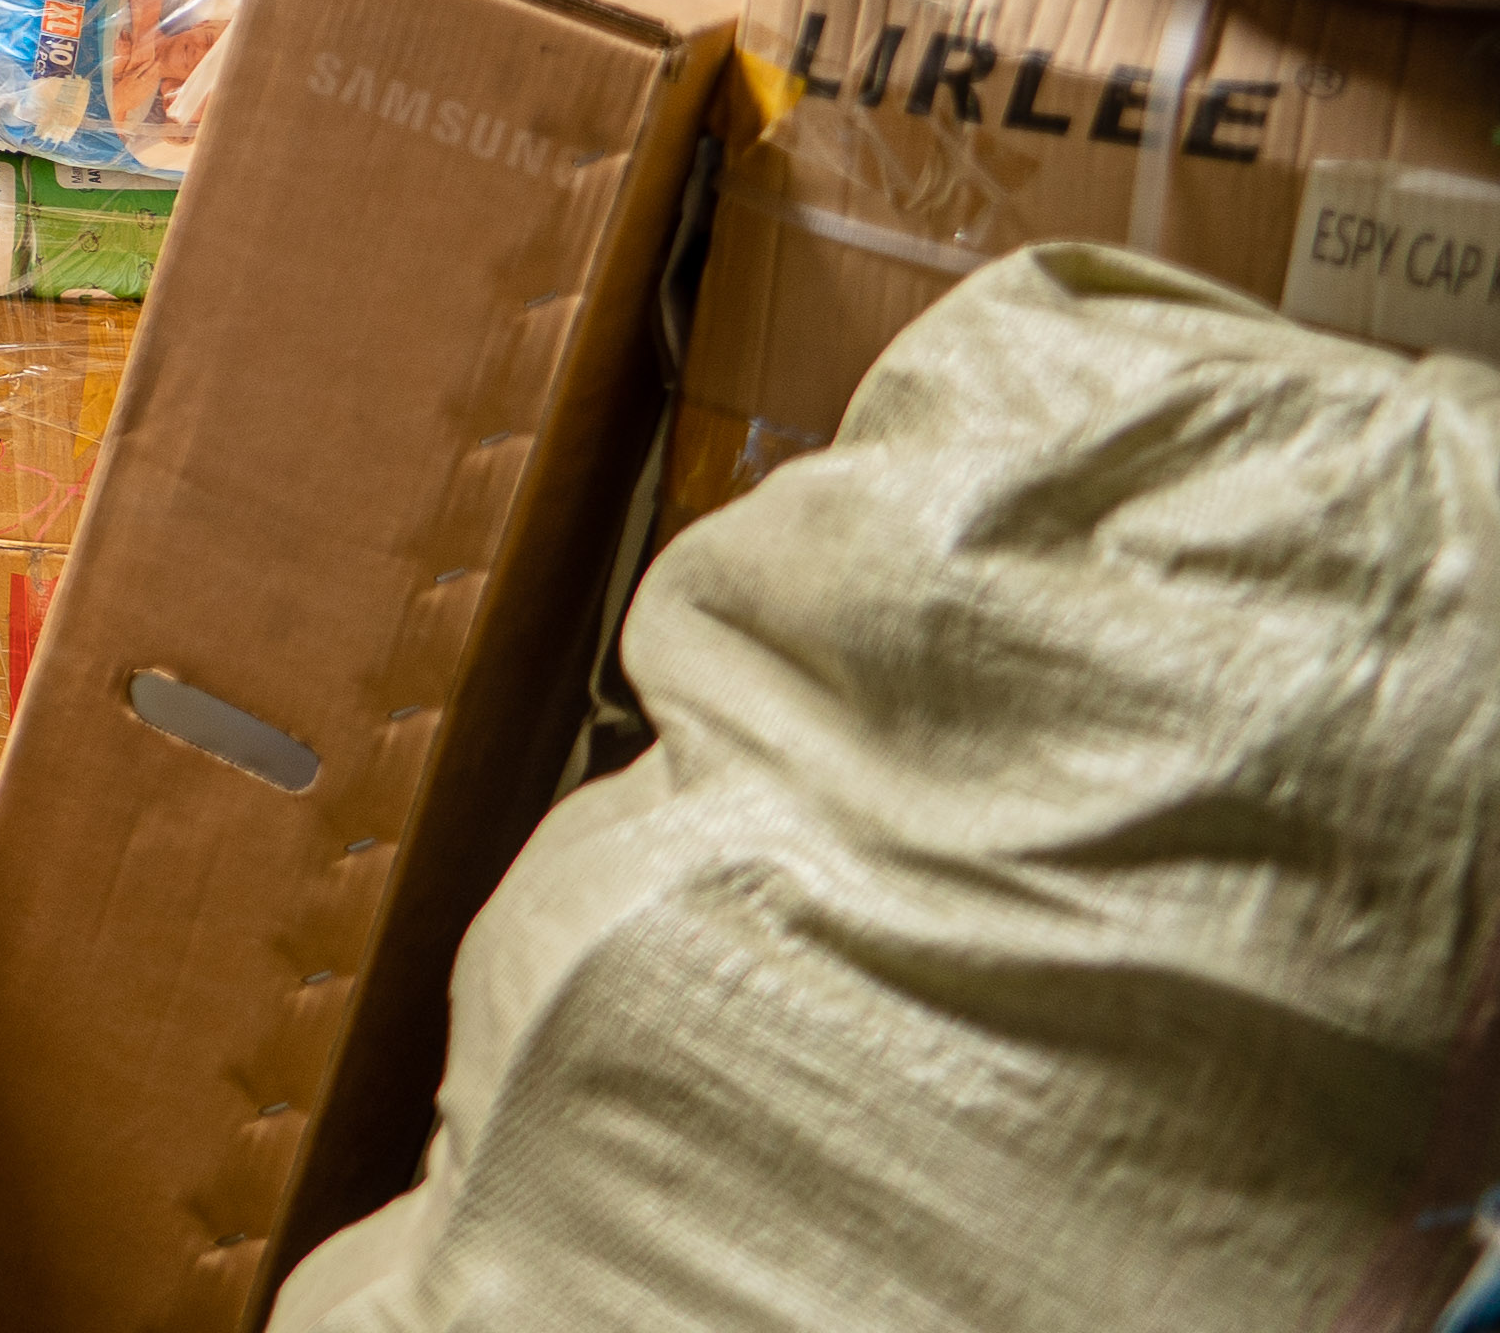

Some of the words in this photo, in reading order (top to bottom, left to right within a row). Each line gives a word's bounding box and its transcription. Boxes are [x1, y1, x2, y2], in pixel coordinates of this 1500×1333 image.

[44, 3, 81, 35] XL
[48, 38, 76, 66] 10
[793, 11, 1281, 165] LIRLEE
[1311, 207, 1401, 275] ESPY
[1405, 229, 1484, 297] CAP
